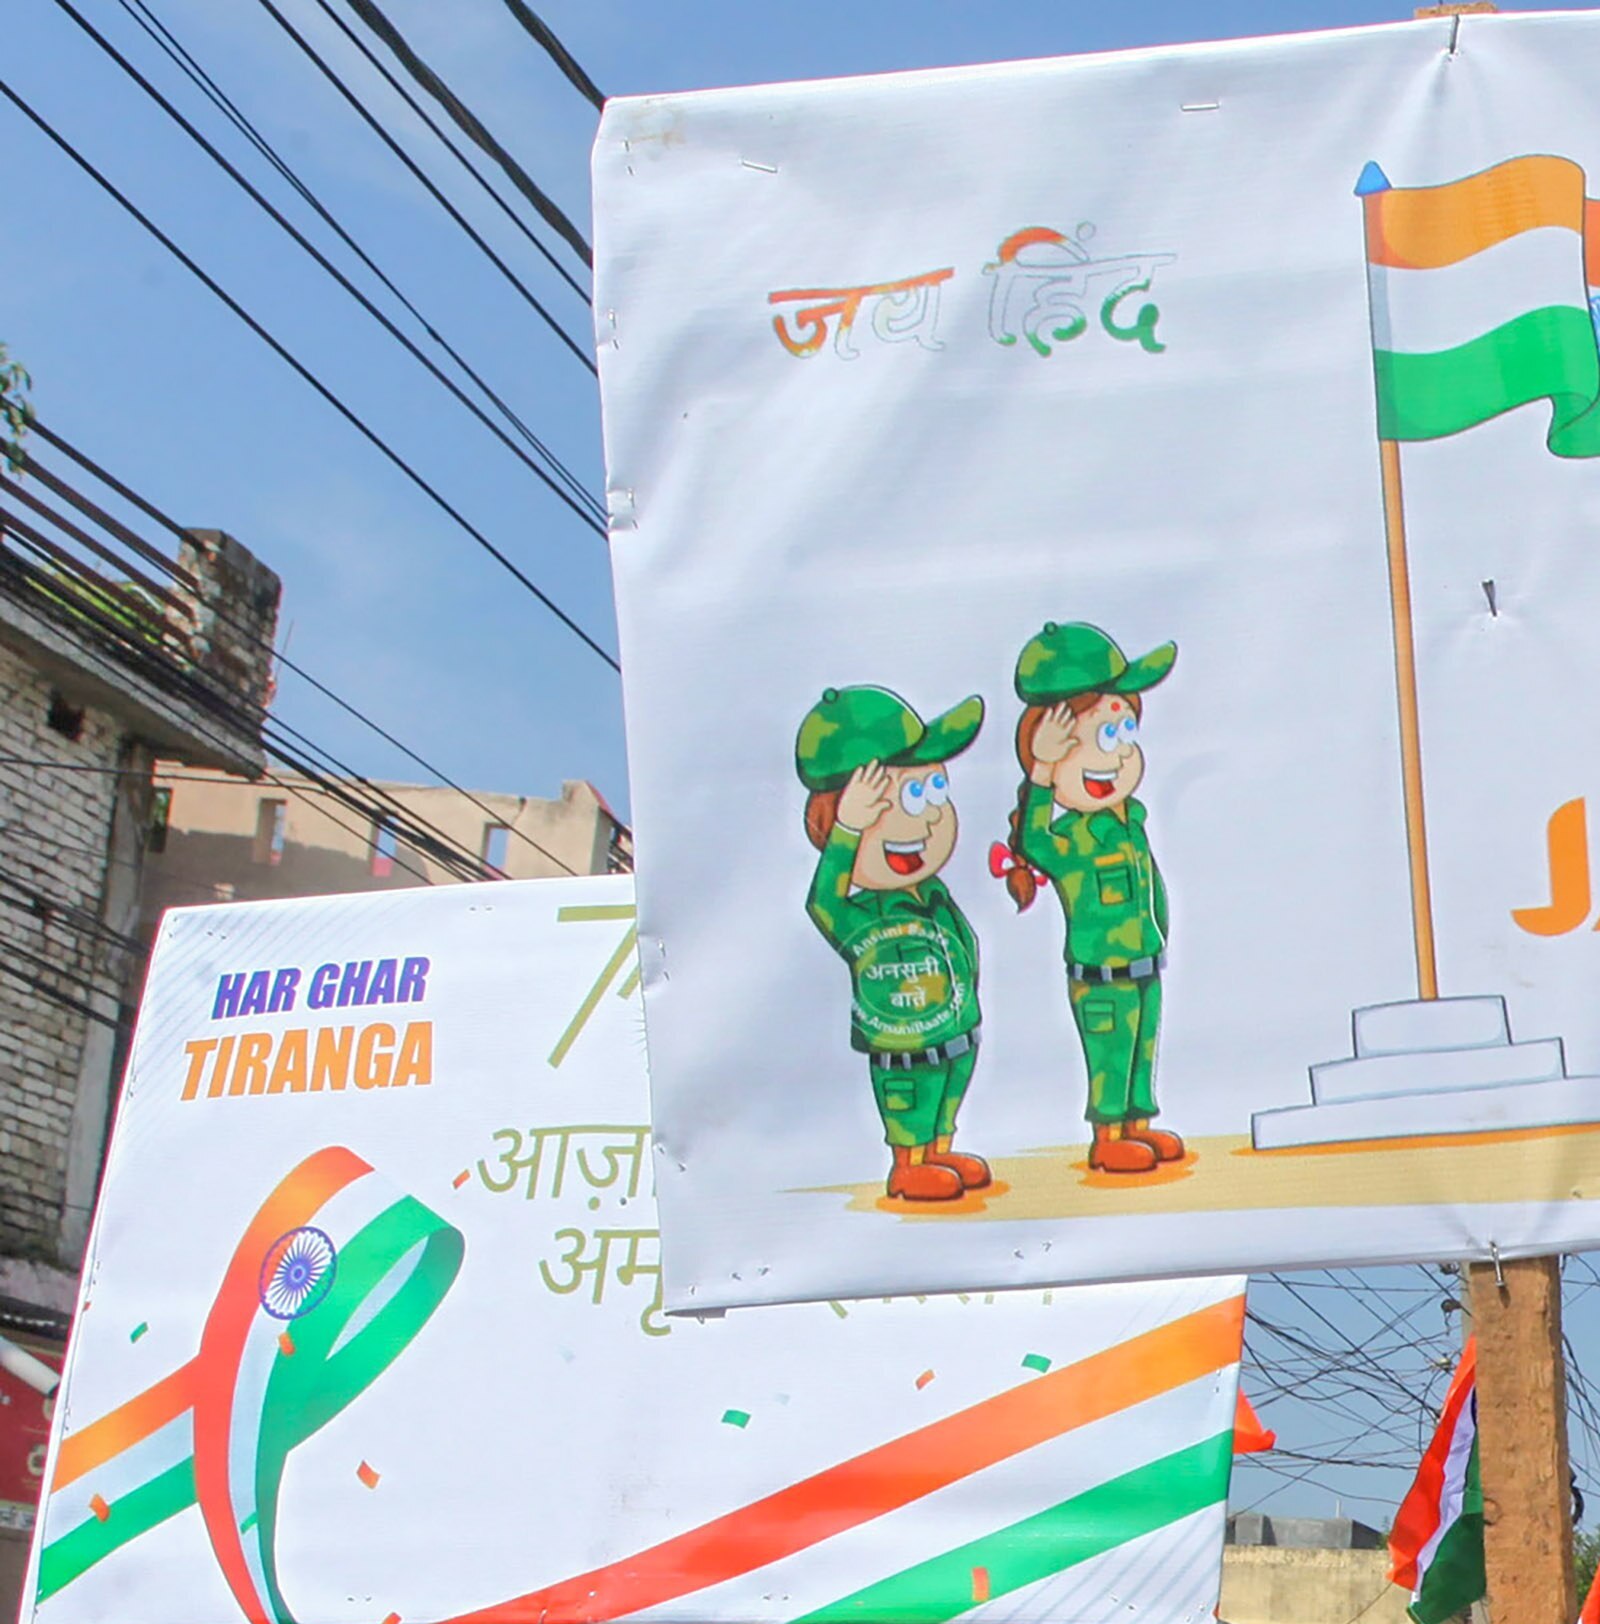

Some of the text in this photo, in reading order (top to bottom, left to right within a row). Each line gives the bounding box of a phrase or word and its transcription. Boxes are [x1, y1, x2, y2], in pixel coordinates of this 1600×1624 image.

[767, 221, 1178, 361] जय हिंद
[211, 956, 431, 1020] HAR GHAR
[180, 1021, 434, 1101] TIRANGA
